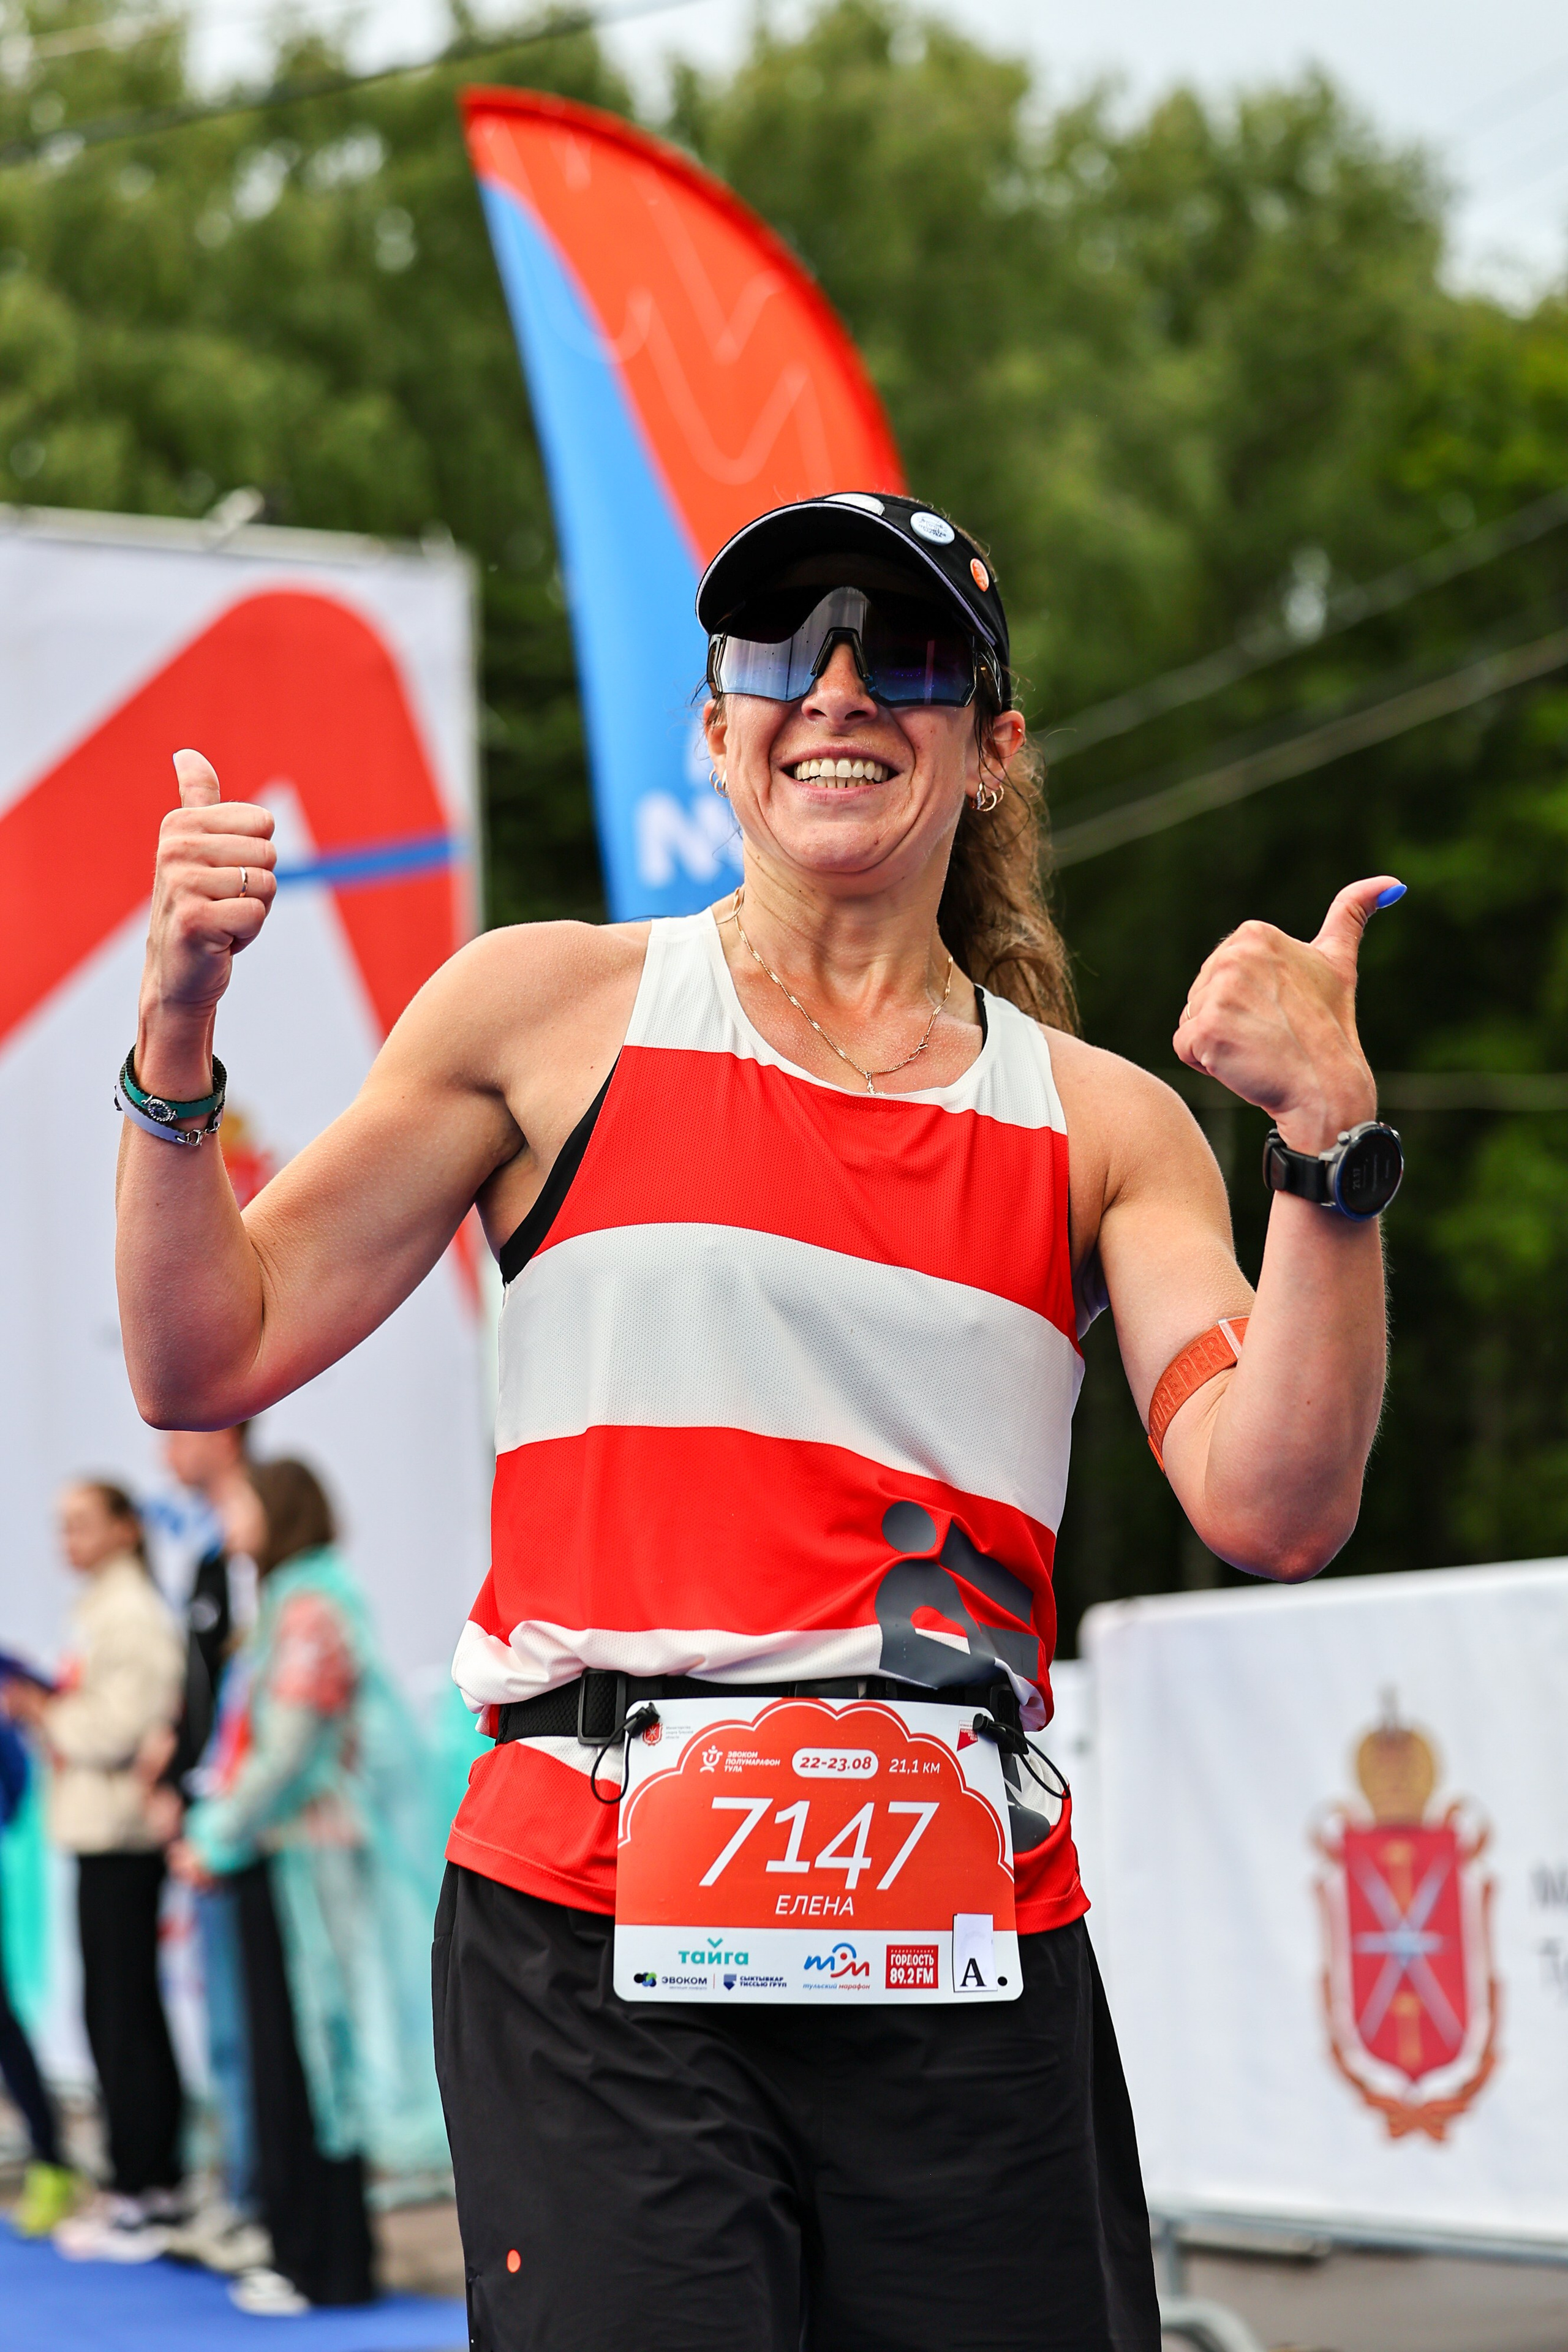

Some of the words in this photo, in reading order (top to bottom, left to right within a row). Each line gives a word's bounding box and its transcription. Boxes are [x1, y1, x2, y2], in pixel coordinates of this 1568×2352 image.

[799, 1756, 872, 1772] 22-23.08
[888, 1758, 919, 1774] 21,1
[698, 1796, 940, 1890] 7147
[775, 1894, 854, 1916] ЕЛЕНА
[678, 1937, 748, 1965] тайга
[890, 1954, 935, 1966] ГОРДОСТЬ
[662, 1976, 707, 1985] ЭВОКОМ
[890, 1967, 914, 1985] 89.2
[916, 1967, 934, 1985] FM
